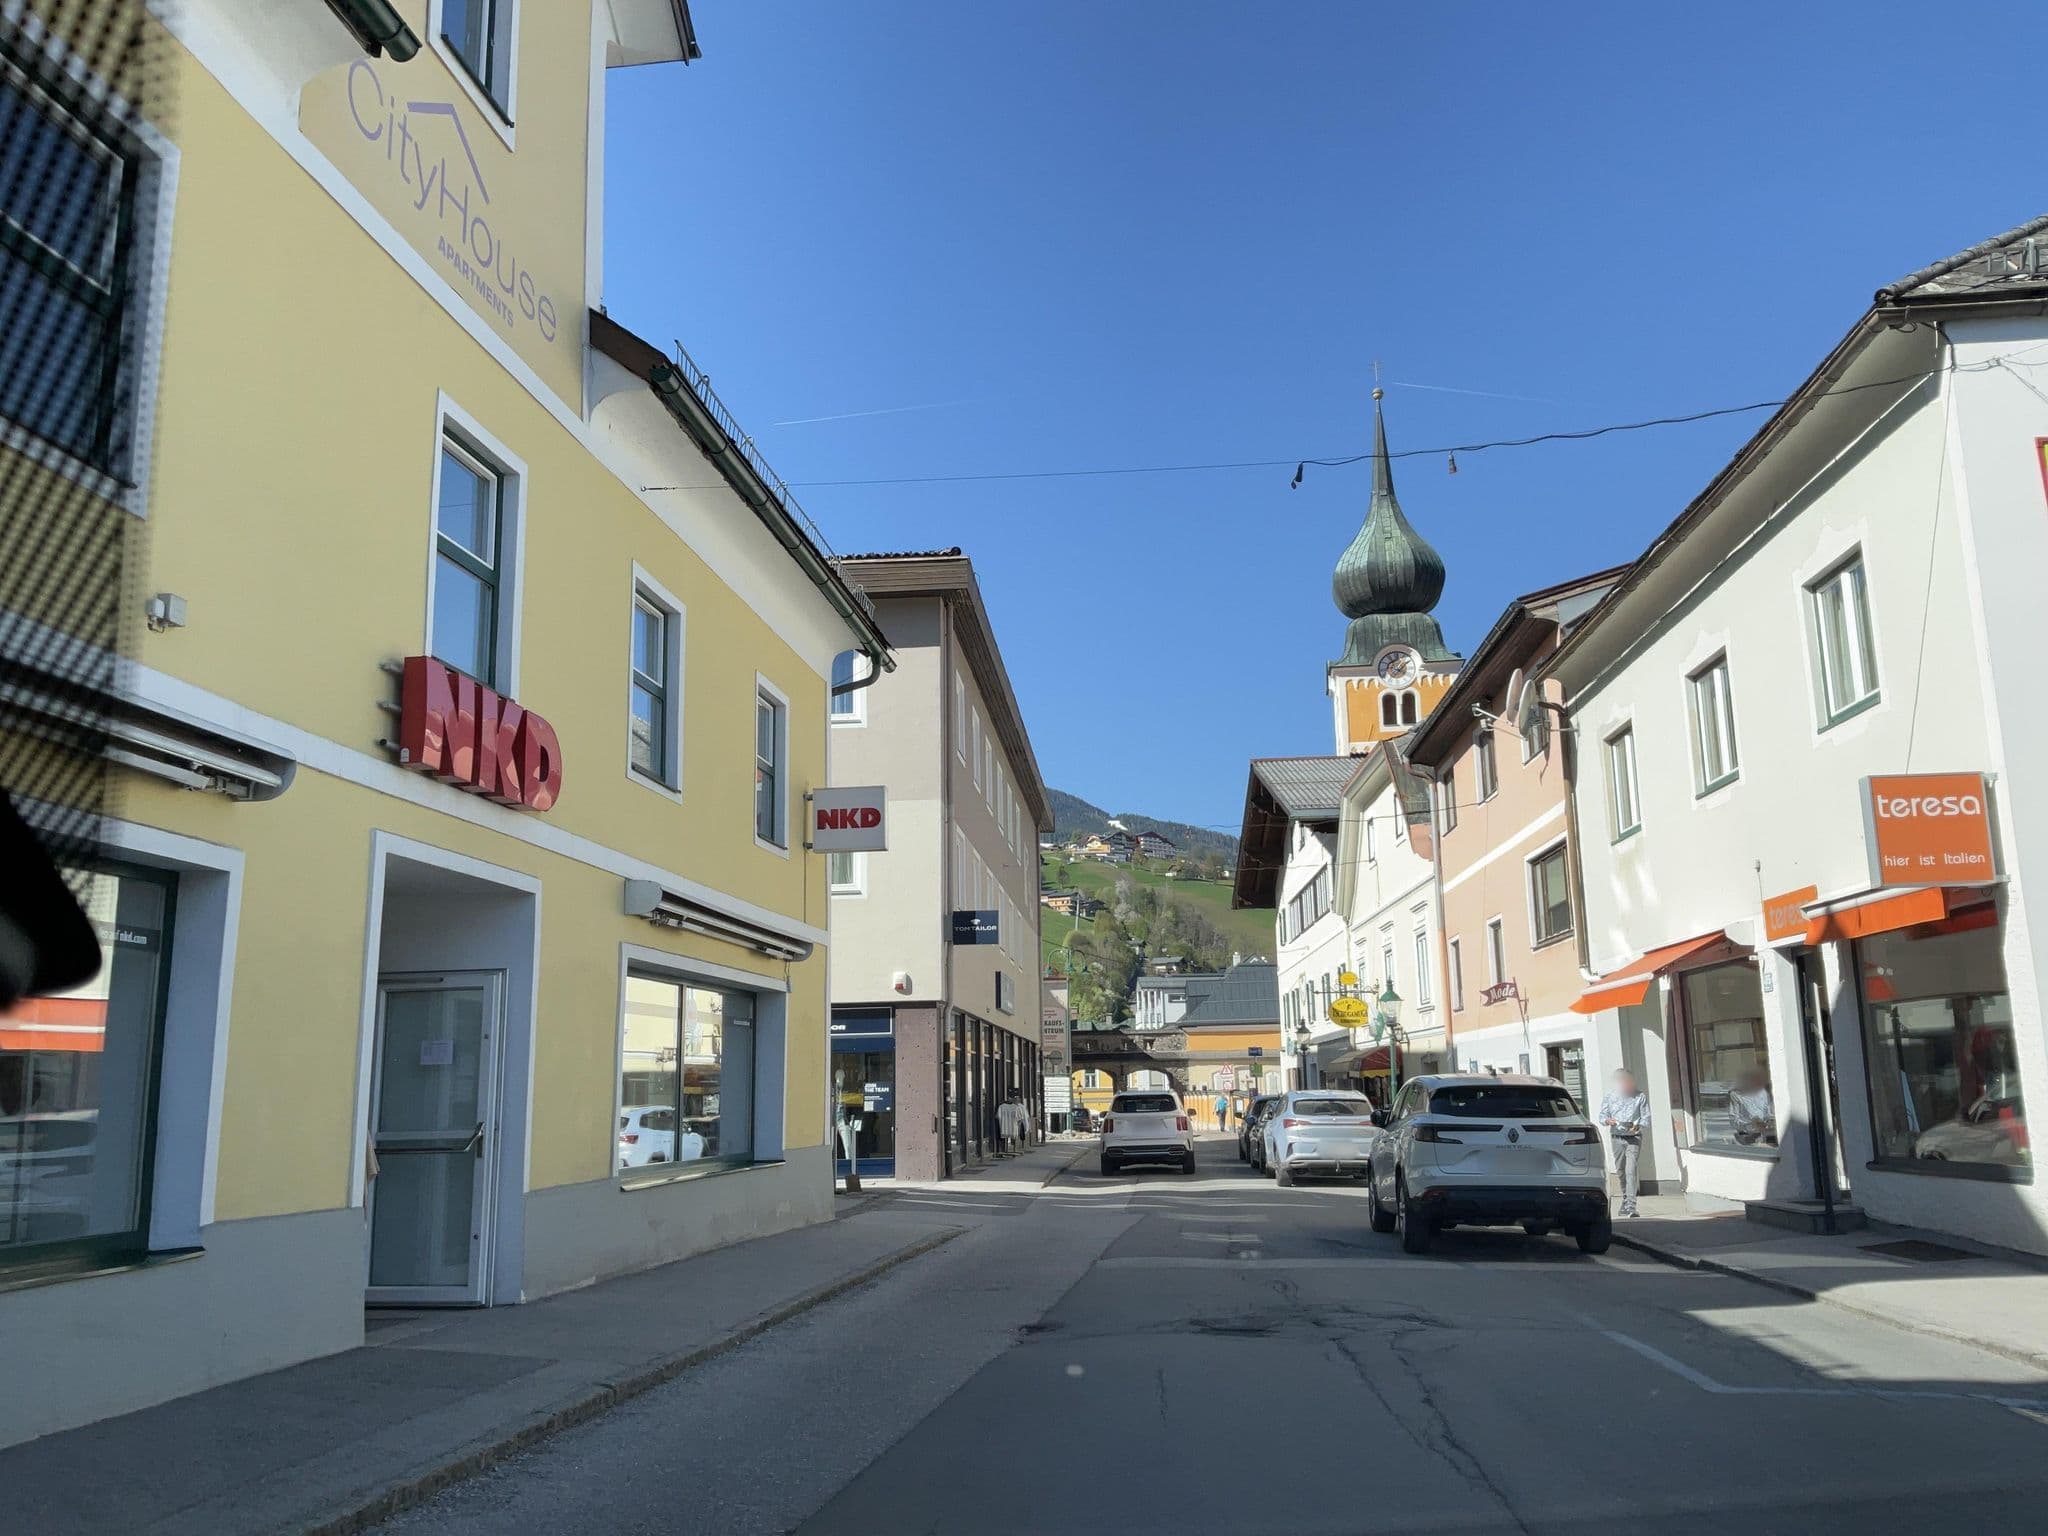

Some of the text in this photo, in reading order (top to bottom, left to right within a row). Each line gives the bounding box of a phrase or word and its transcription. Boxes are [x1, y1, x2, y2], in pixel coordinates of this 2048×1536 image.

[438, 235, 514, 327] APARTMENTS
[404, 656, 562, 811] NKD
[1876, 793, 1981, 818] teresa
[816, 807, 882, 830] NKD
[1884, 852, 1986, 867] hier ist Italien
[1769, 901, 1805, 930] teres
[1489, 984, 1515, 1002] Mode
